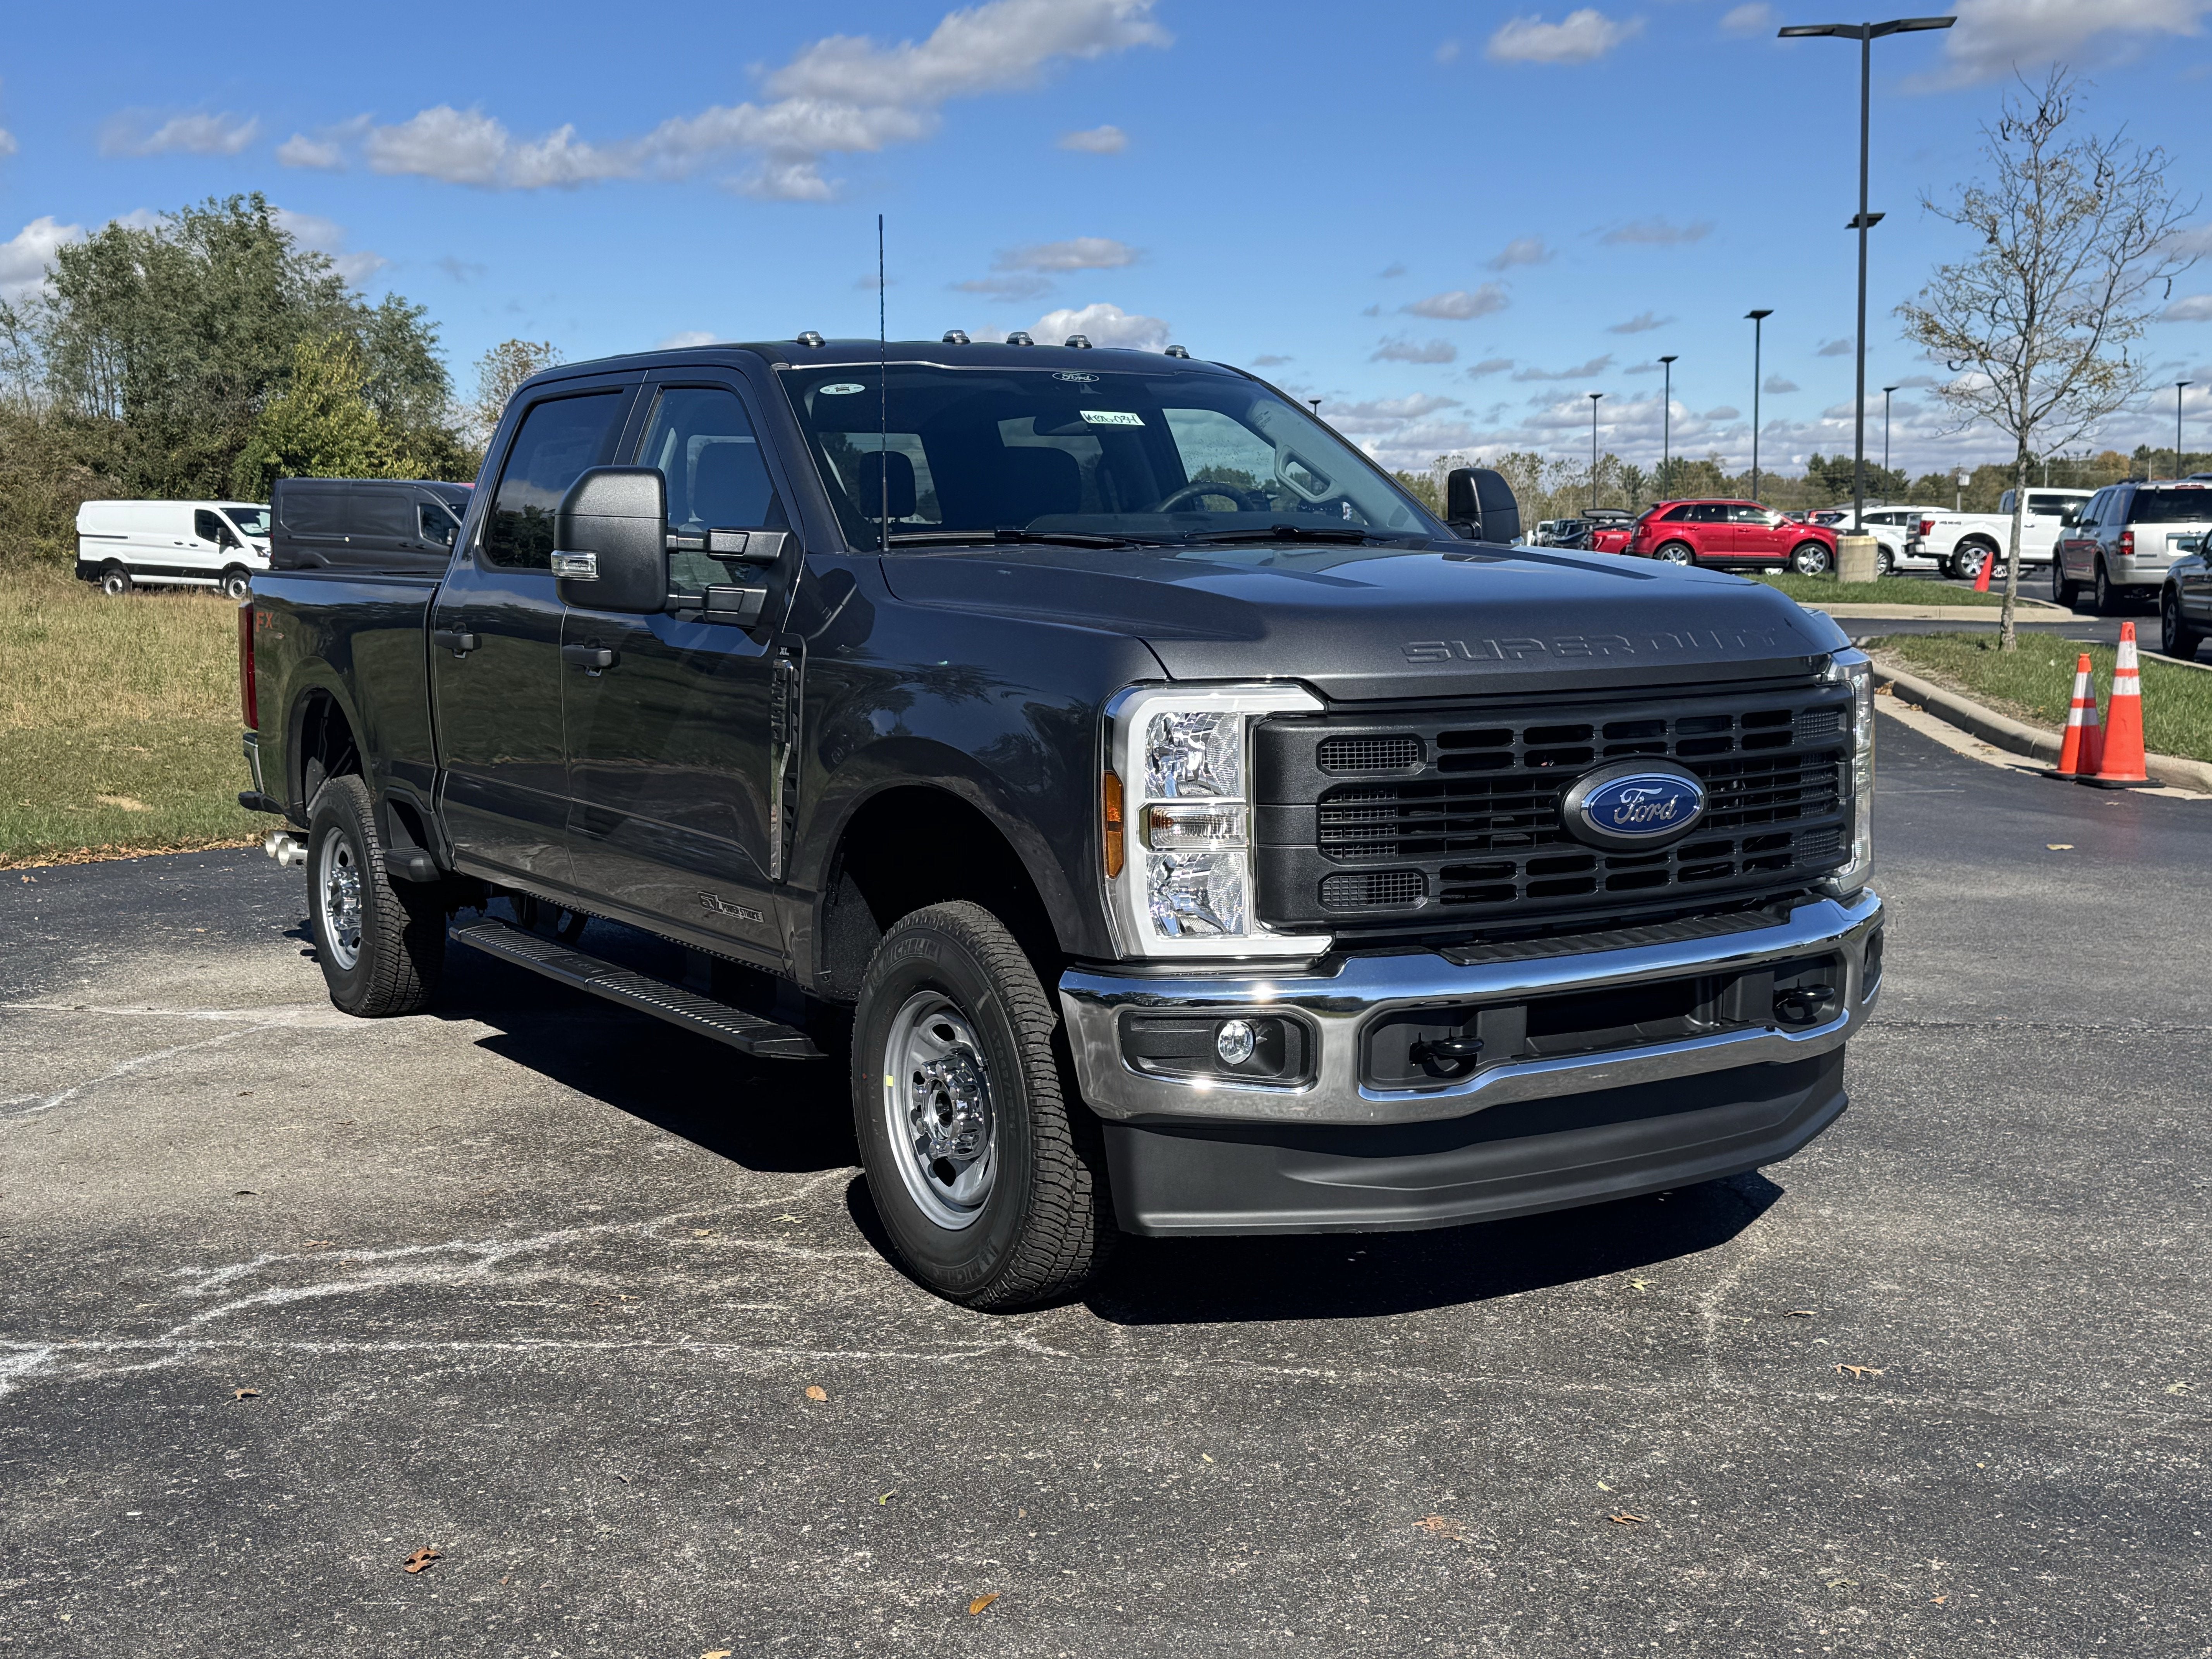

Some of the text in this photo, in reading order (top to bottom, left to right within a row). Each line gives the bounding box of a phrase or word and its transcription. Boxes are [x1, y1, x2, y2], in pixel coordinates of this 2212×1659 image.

[779, 647, 790, 656] XL
[1401, 627, 1778, 664] SUPER DUTY
[1614, 788, 1679, 824] Ford
[883, 938, 940, 967] MICHELIN
